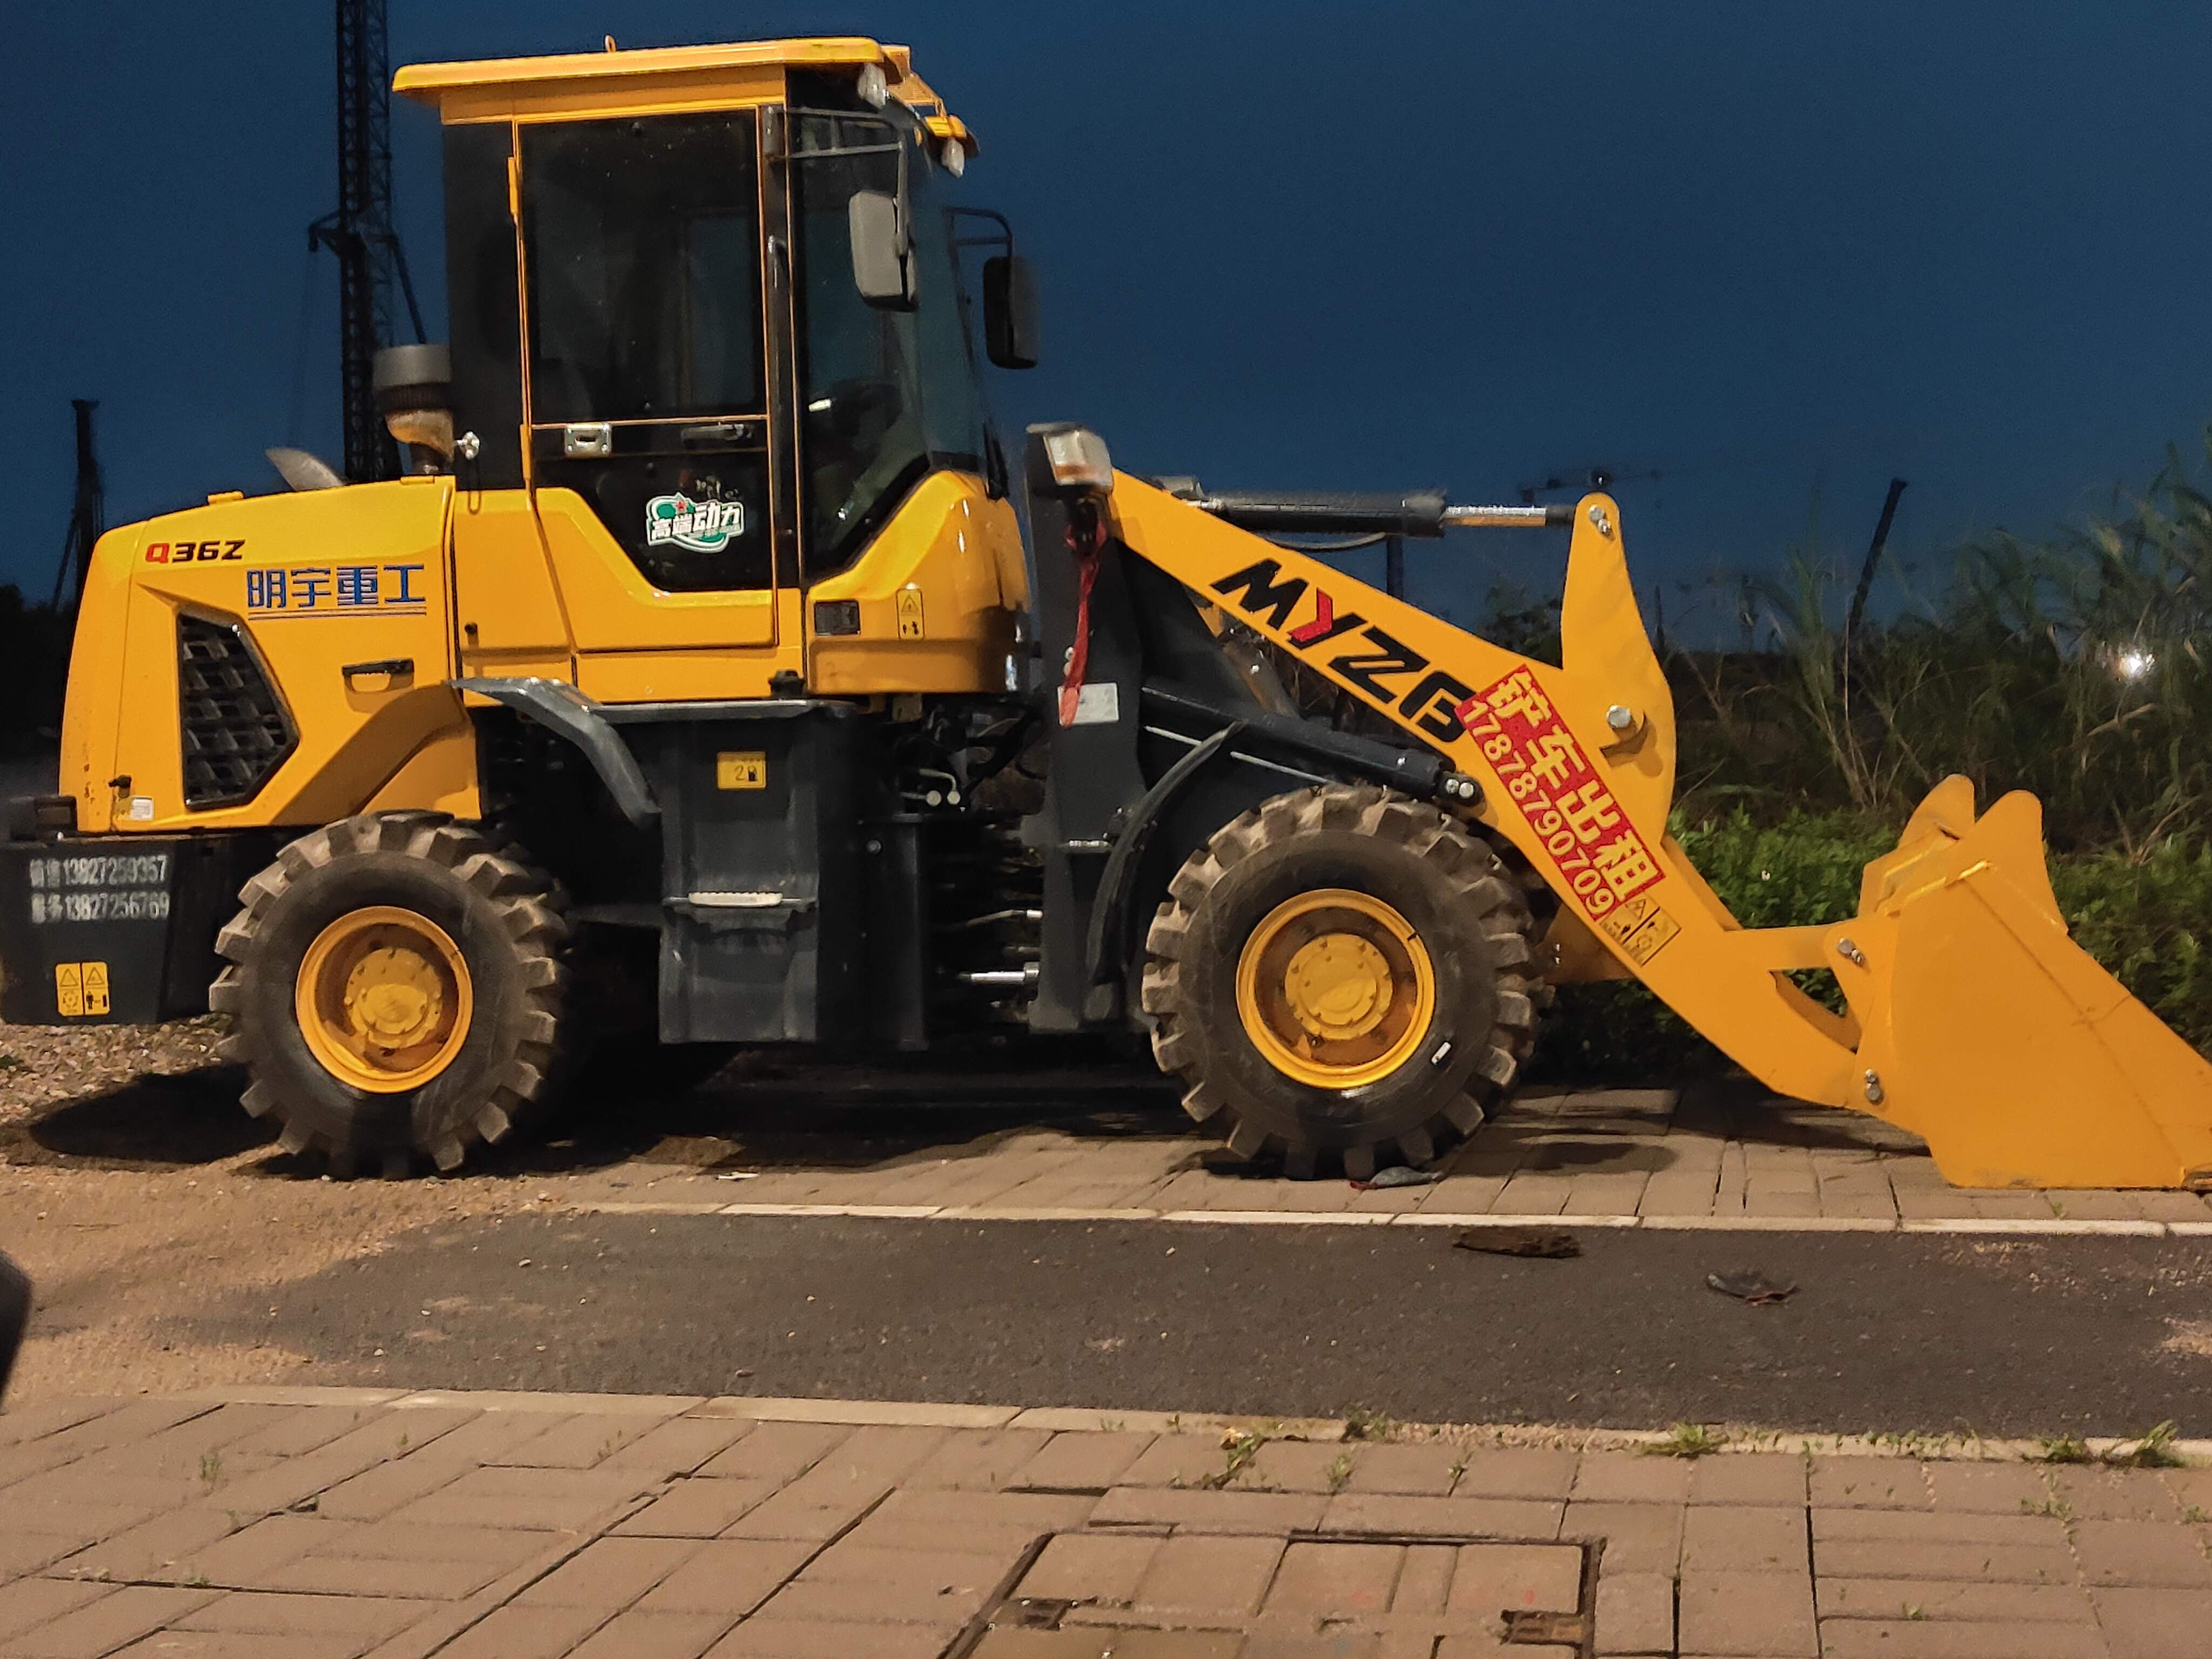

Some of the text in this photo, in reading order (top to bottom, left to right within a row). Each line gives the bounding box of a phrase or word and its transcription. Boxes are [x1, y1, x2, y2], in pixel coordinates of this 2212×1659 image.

[651, 501, 740, 540] 高端动力
[146, 540, 245, 563] Q36Z
[247, 563, 426, 609] 明宇重工
[1487, 670, 1657, 896] 铲车出租
[1464, 699, 1616, 914] 17878790709
